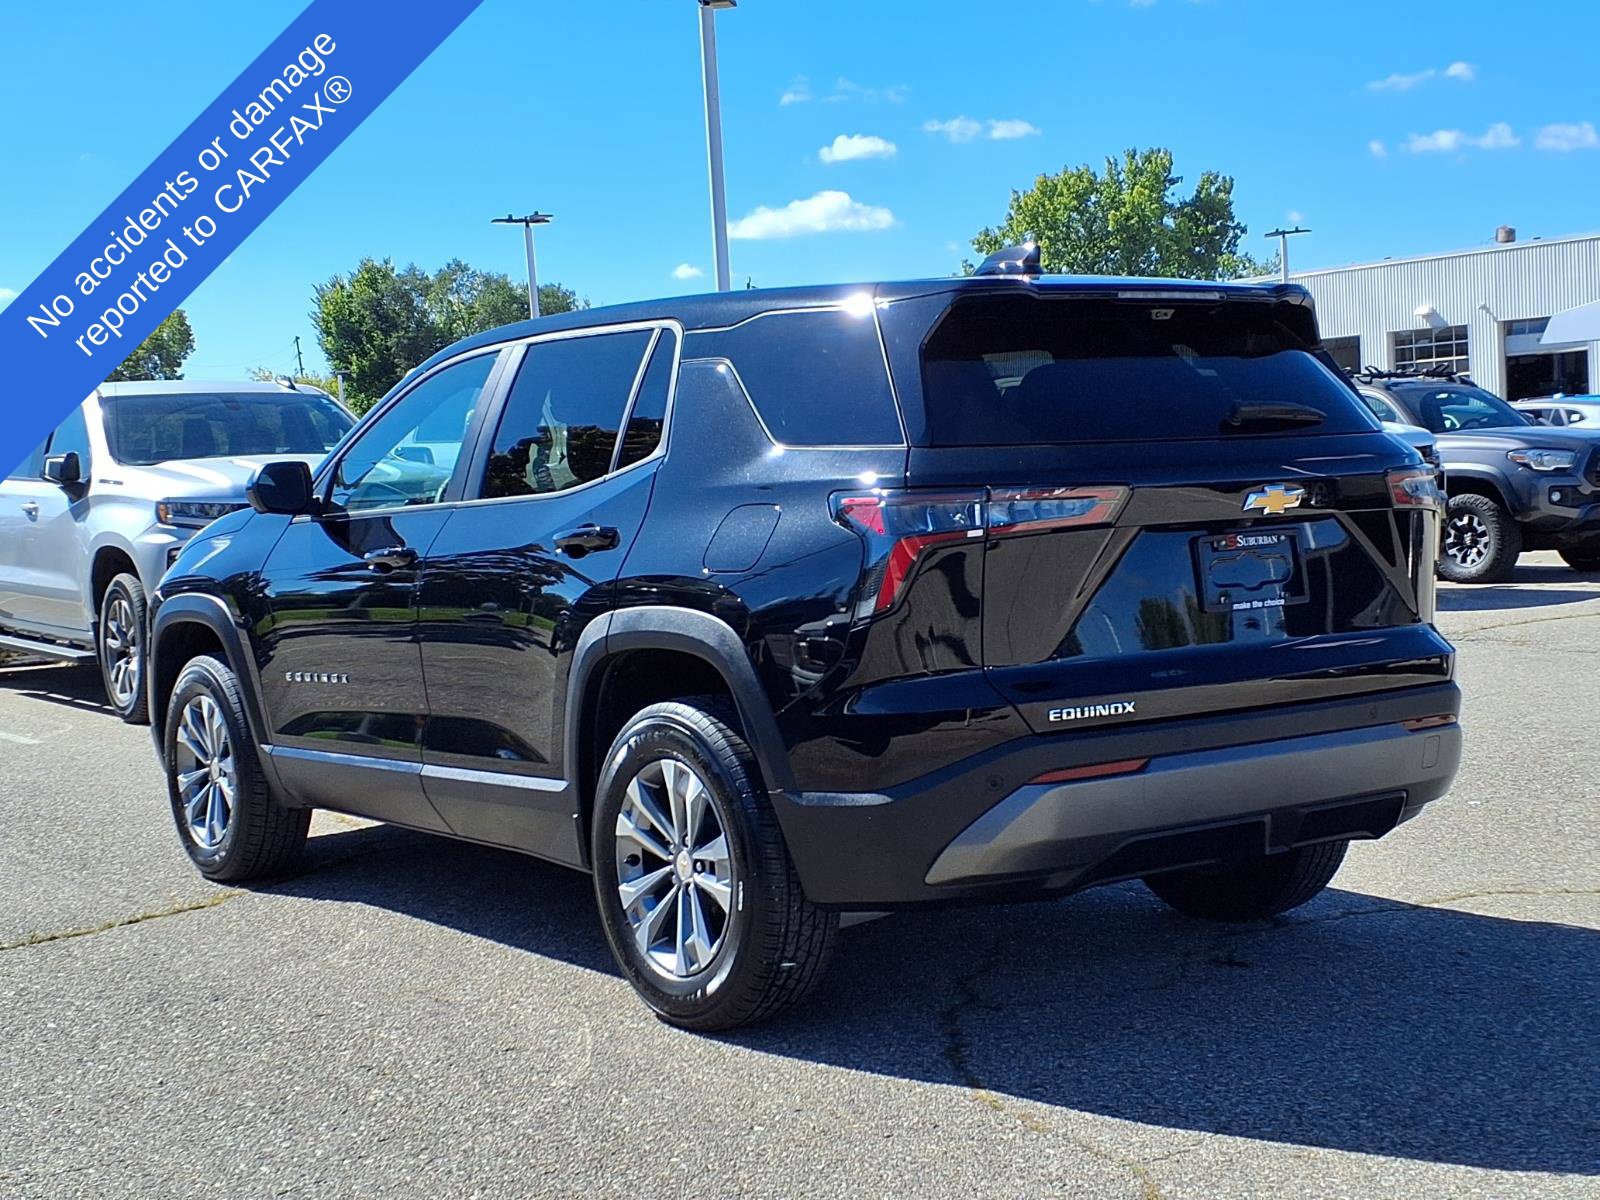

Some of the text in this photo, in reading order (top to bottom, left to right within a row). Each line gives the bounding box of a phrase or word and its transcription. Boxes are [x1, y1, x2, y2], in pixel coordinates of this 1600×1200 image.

[1233, 598, 1285, 610] make the choice
[285, 671, 347, 683] EQUINOX
[1048, 701, 1136, 722] EQUINOX
